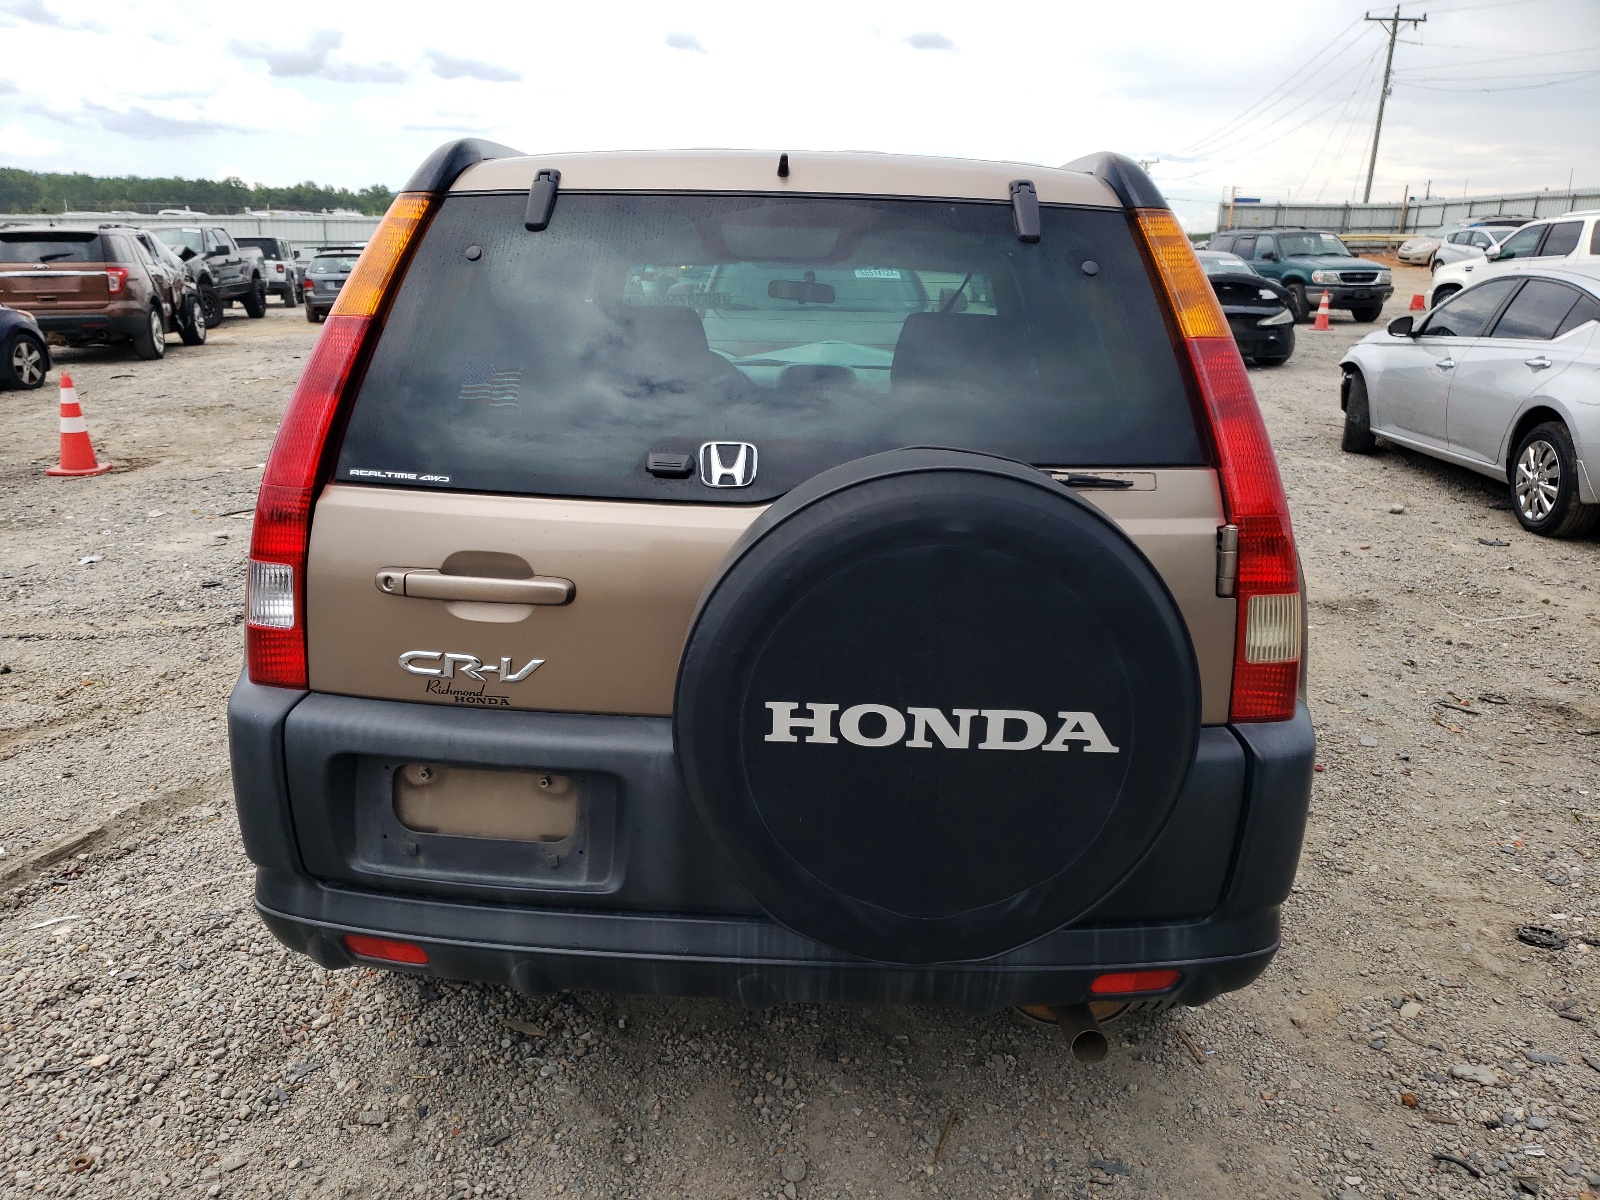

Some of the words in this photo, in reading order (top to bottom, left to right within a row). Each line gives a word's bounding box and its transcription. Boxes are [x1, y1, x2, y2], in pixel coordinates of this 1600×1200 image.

[349, 469, 418, 480] REALTIME
[419, 474, 450, 483] 4WD
[397, 650, 547, 683] CR-V
[425, 679, 486, 697] Richmond
[454, 695, 511, 706] HONDA
[764, 701, 1120, 753] HONDA
